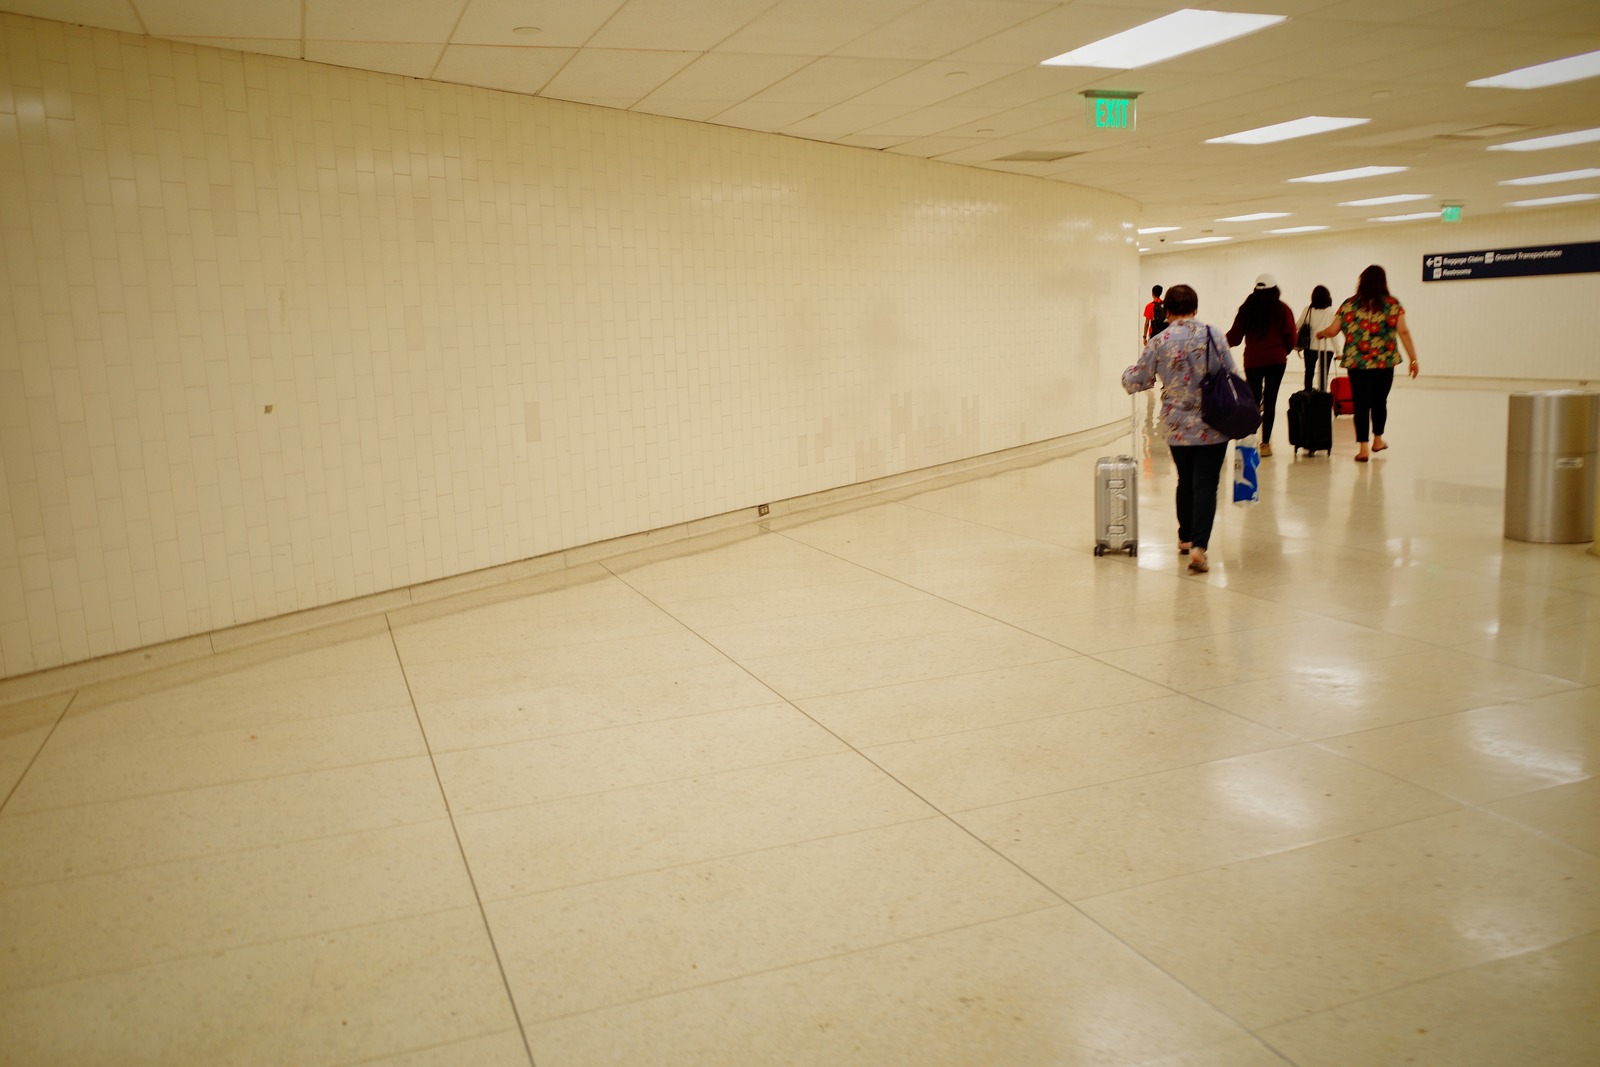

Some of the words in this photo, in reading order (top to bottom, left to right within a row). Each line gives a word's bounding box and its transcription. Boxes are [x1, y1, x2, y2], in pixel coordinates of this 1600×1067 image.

[1095, 98, 1129, 128] EXIT
[1443, 257, 1467, 266] Baggage
[1467, 256, 1484, 264] Claim
[1495, 253, 1518, 262] Ground
[1518, 250, 1563, 261] Transportation
[1443, 269, 1472, 277] Restrooms
